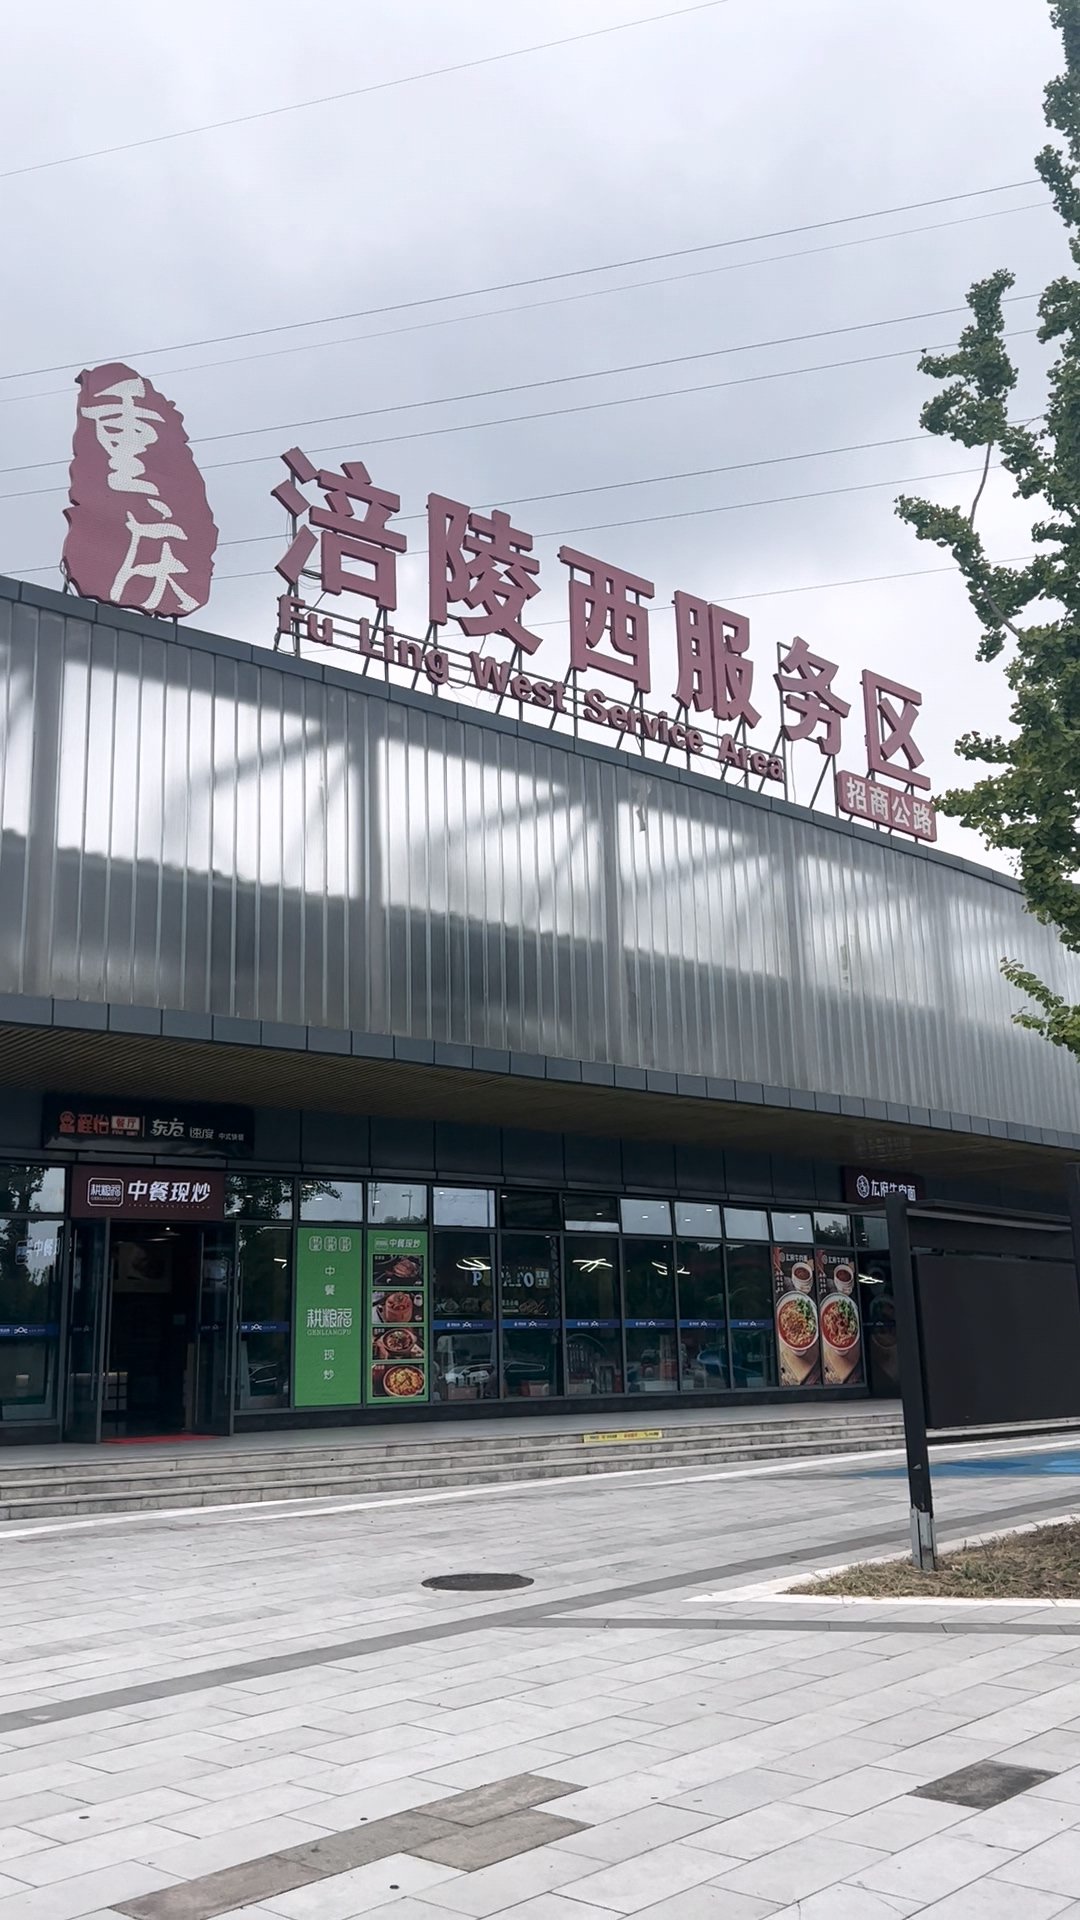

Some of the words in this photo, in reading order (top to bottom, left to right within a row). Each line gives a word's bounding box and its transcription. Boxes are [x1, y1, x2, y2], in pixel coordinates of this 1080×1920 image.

[80, 376, 202, 612] 重庆
[270, 446, 932, 791] 涪陵西服务区
[277, 594, 334, 645] Fu
[359, 617, 449, 685] Ling
[469, 651, 567, 713] West
[583, 688, 704, 754] Service
[717, 733, 785, 783] Area
[846, 776, 933, 836] 招商公路
[150, 1117, 185, 1138] 东方
[127, 1180, 211, 1203] 中餐现炒
[306, 1307, 353, 1328] 耕粮福
